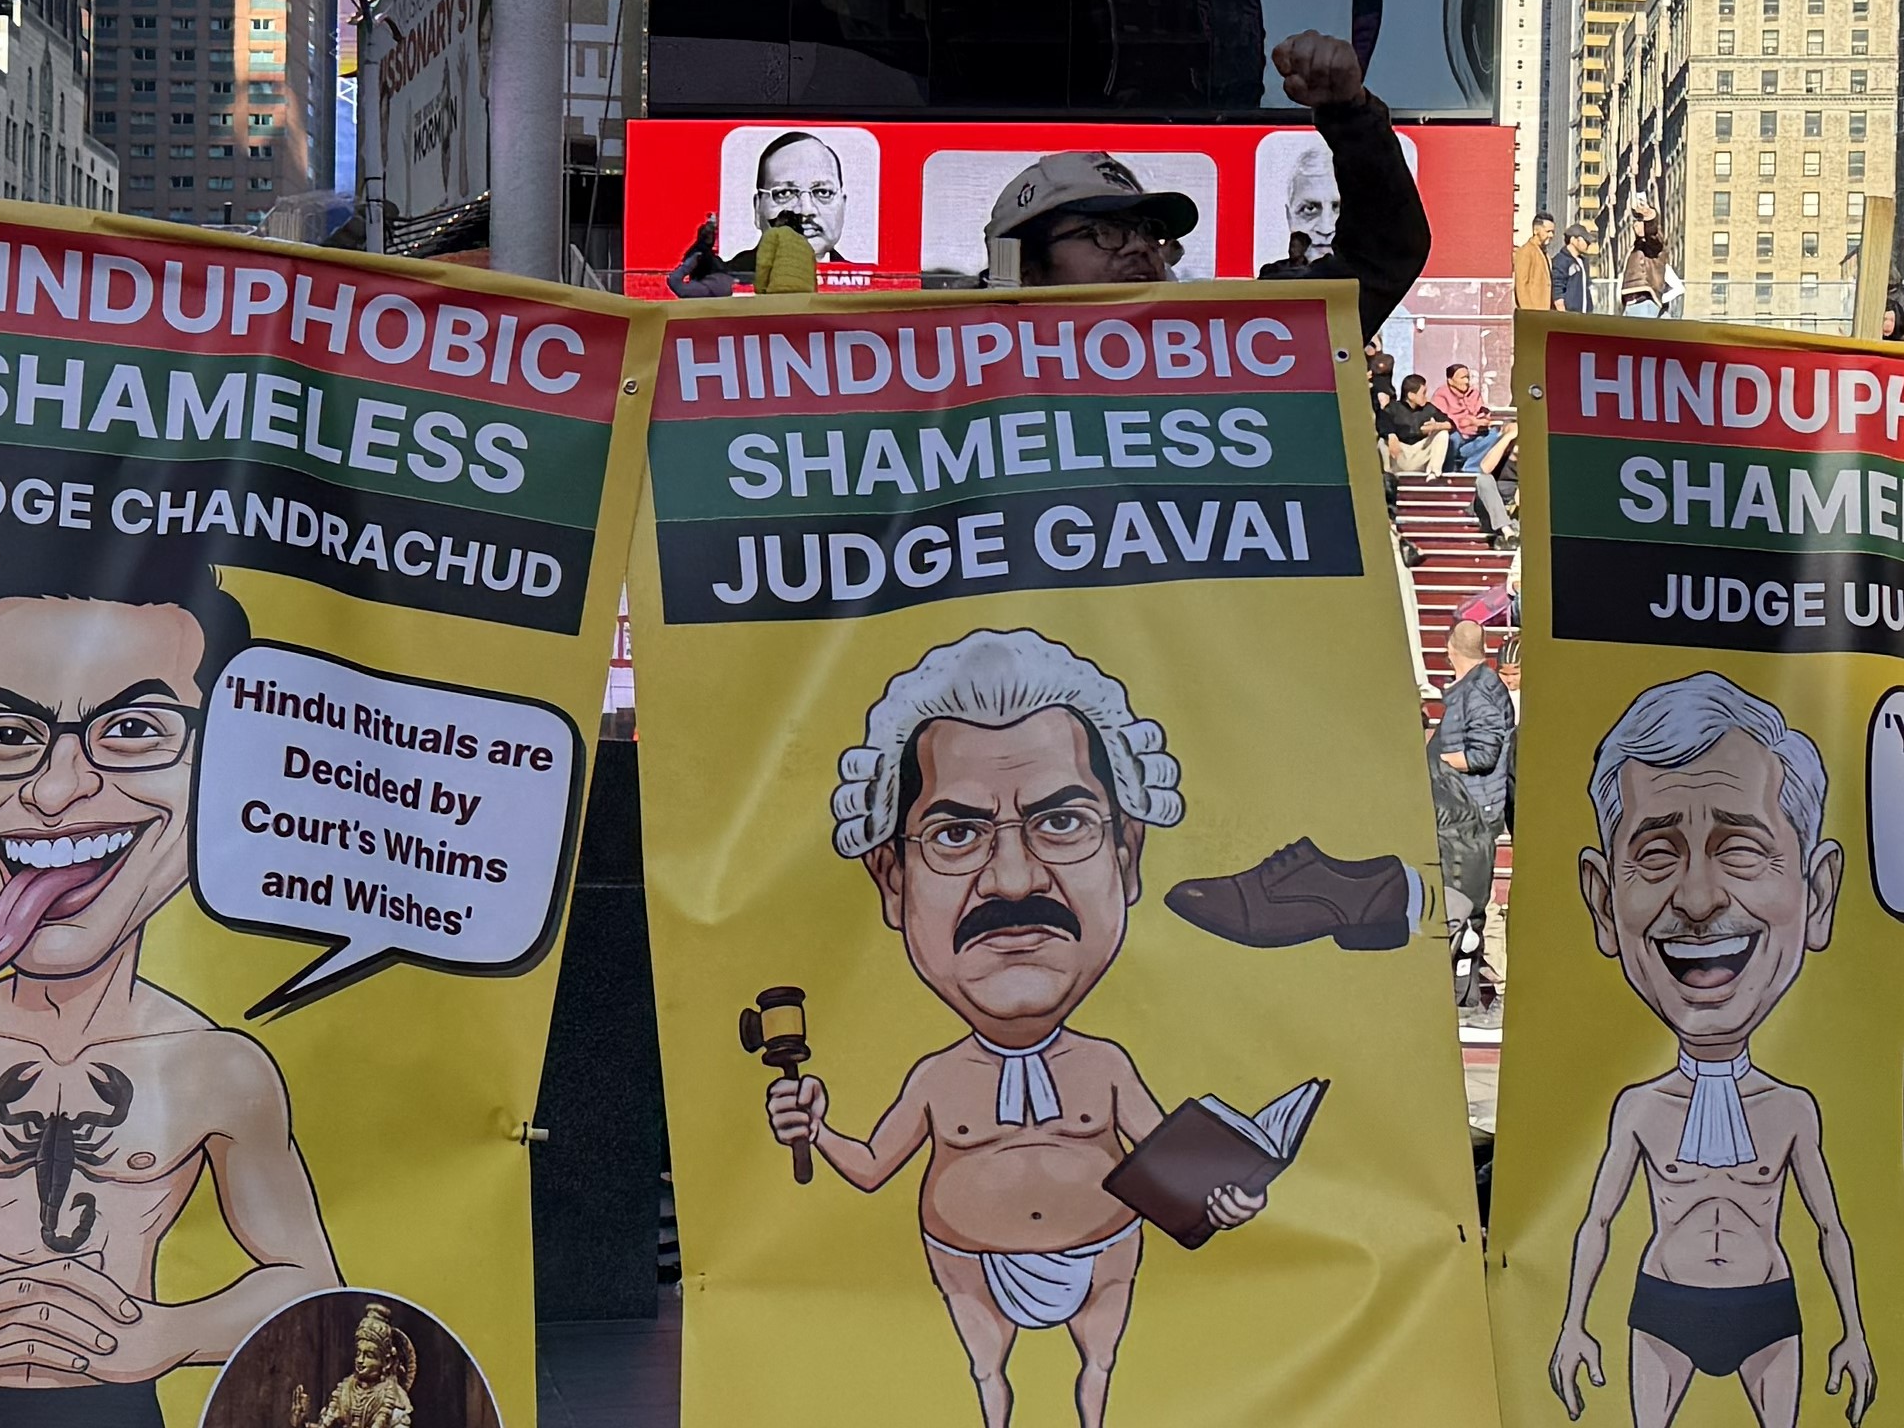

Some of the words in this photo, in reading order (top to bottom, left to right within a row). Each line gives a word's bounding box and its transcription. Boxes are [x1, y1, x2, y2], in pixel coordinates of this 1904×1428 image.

[675, 317, 1296, 402] HINDUPHOBIC
[727, 408, 1272, 500] SHAMELESS
[111, 488, 562, 598] CHANDRACHUD
[712, 511, 1009, 604] JUDGE
[1033, 500, 1310, 571] GAVAI
[1649, 574, 1826, 627] JUDGE
[225, 675, 347, 727] 'Hindu
[353, 703, 478, 760] Rituals
[488, 729, 554, 771] are
[284, 746, 420, 809] Decided
[430, 781, 481, 824] by
[241, 800, 377, 855] Court's
[383, 832, 508, 884] Whims
[261, 867, 332, 907] and
[343, 879, 472, 936] Wishes'
